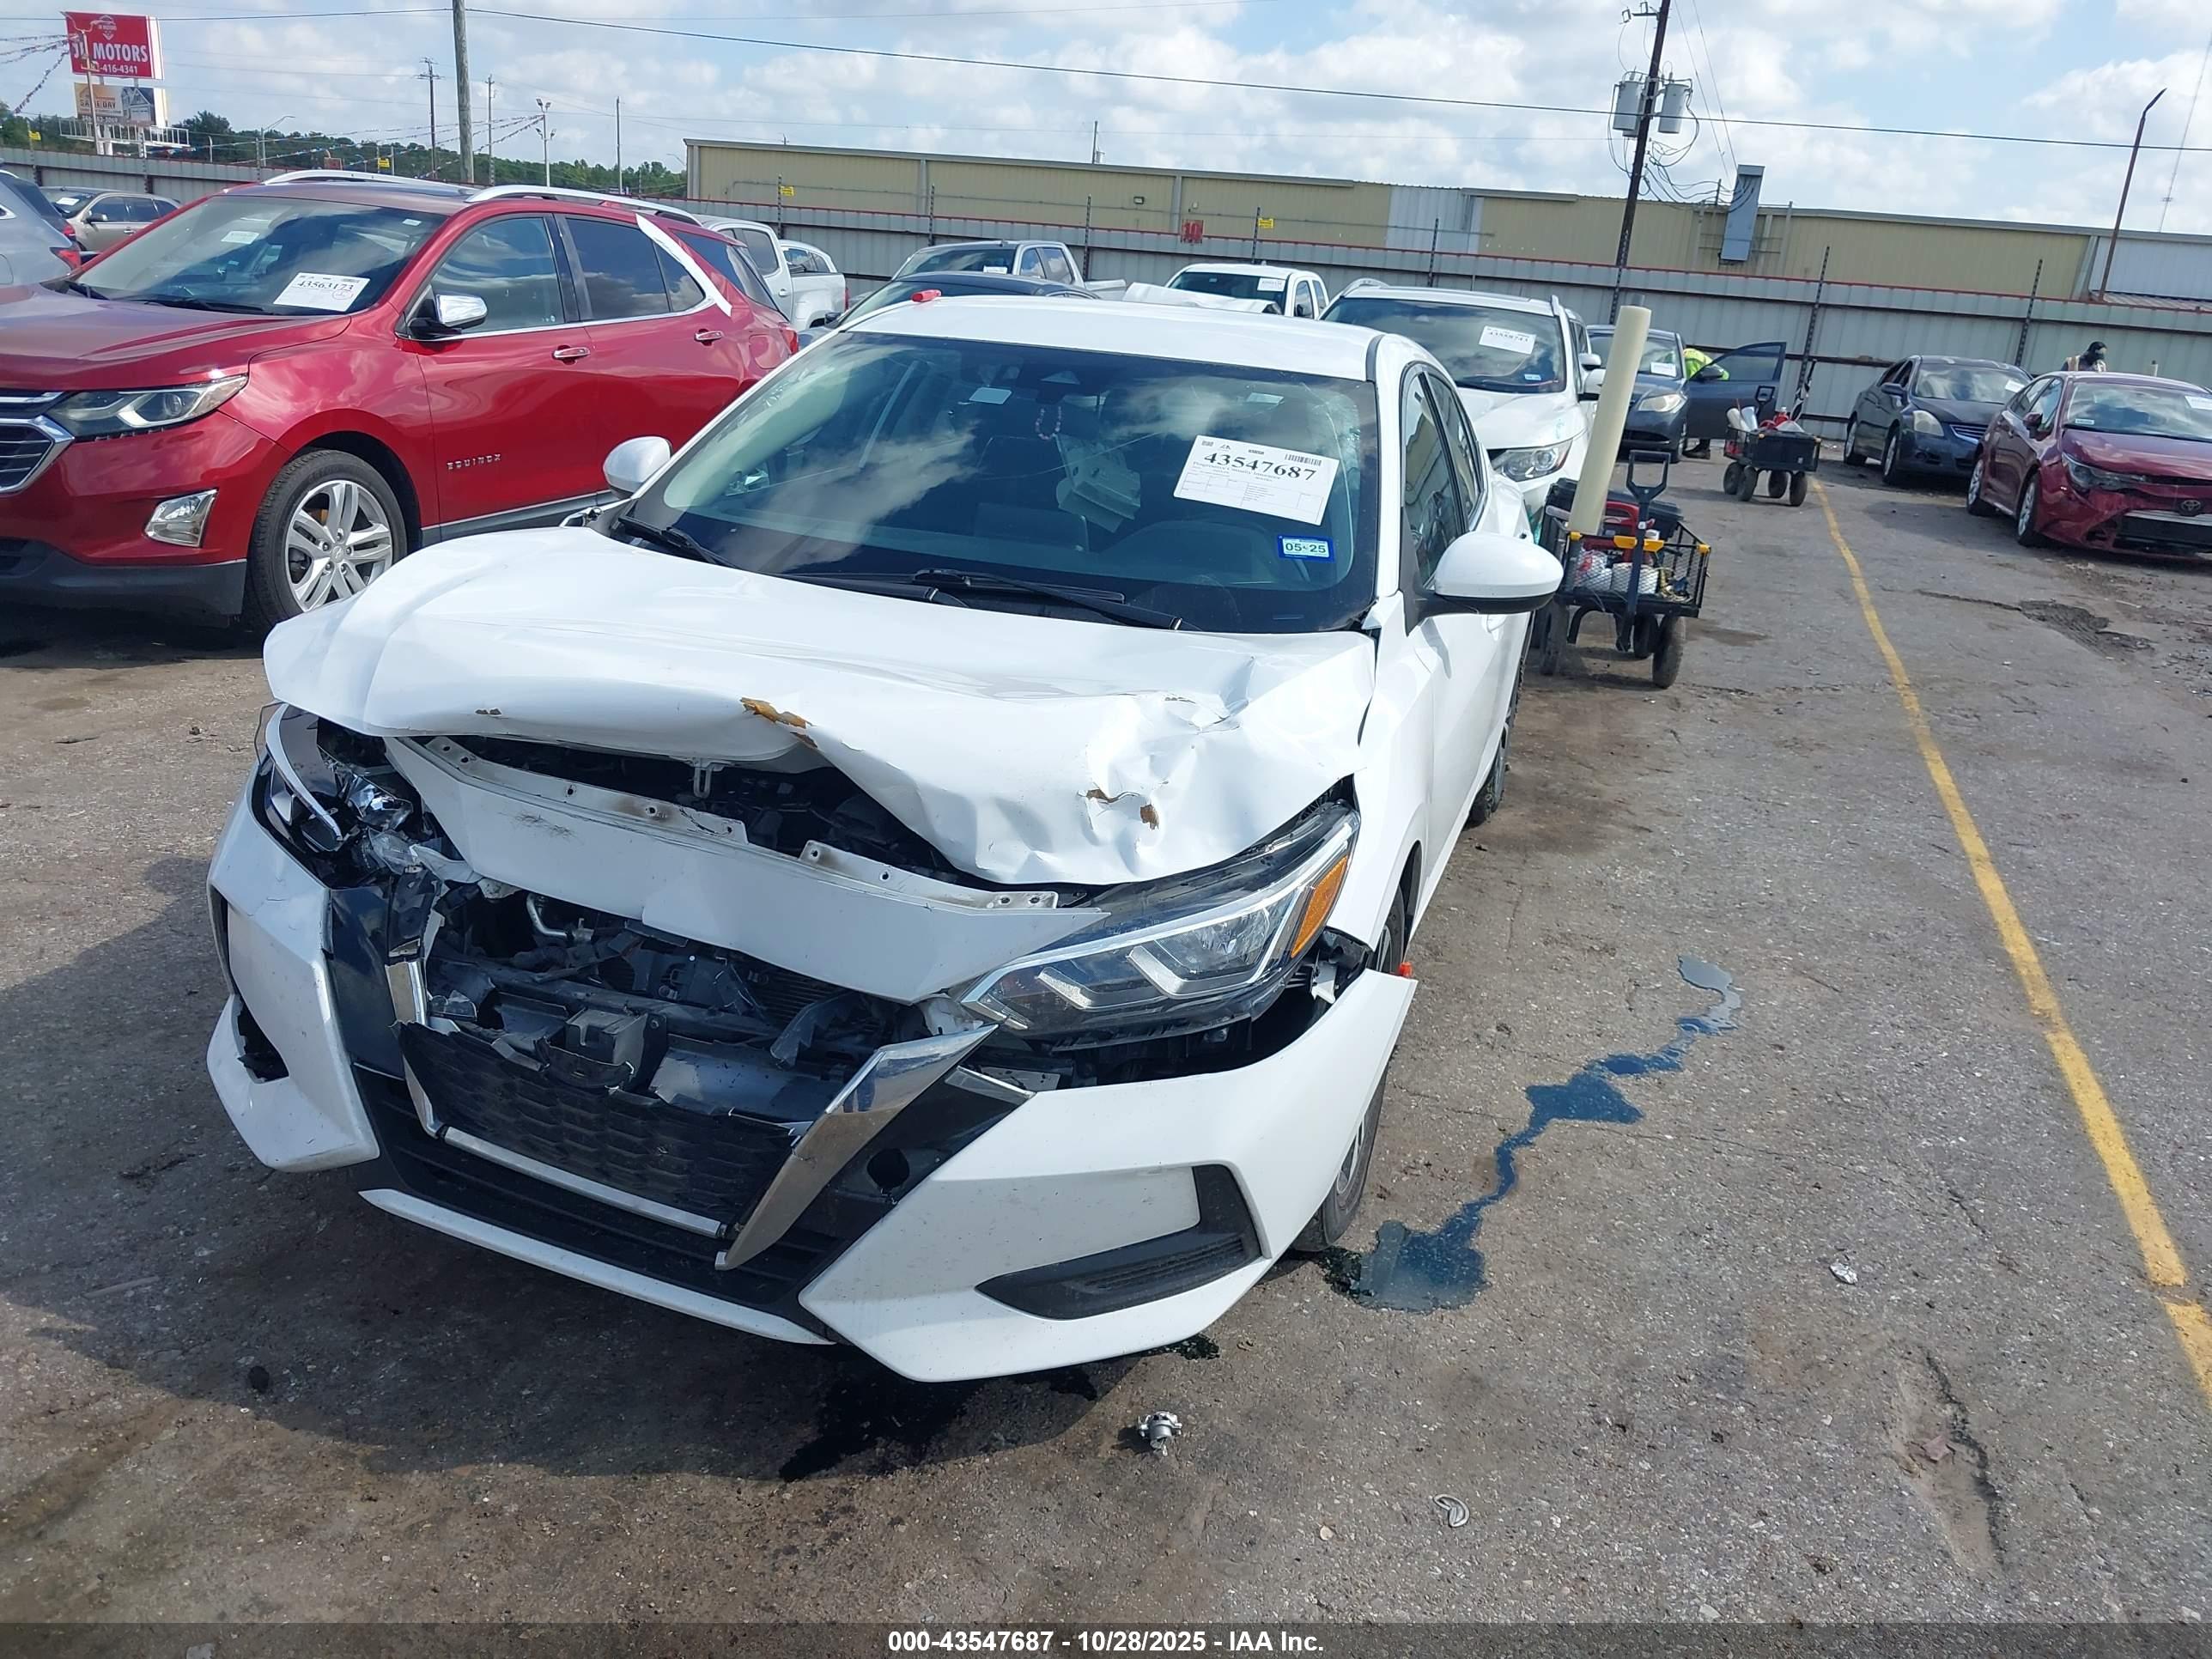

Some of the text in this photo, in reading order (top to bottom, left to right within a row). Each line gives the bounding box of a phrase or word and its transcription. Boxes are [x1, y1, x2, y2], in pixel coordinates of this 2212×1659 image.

[93, 42, 148, 62] MOTORS
[447, 453, 501, 470] EQUINOX
[1204, 453, 1316, 480] 43547687
[1309, 544, 1326, 553] 25
